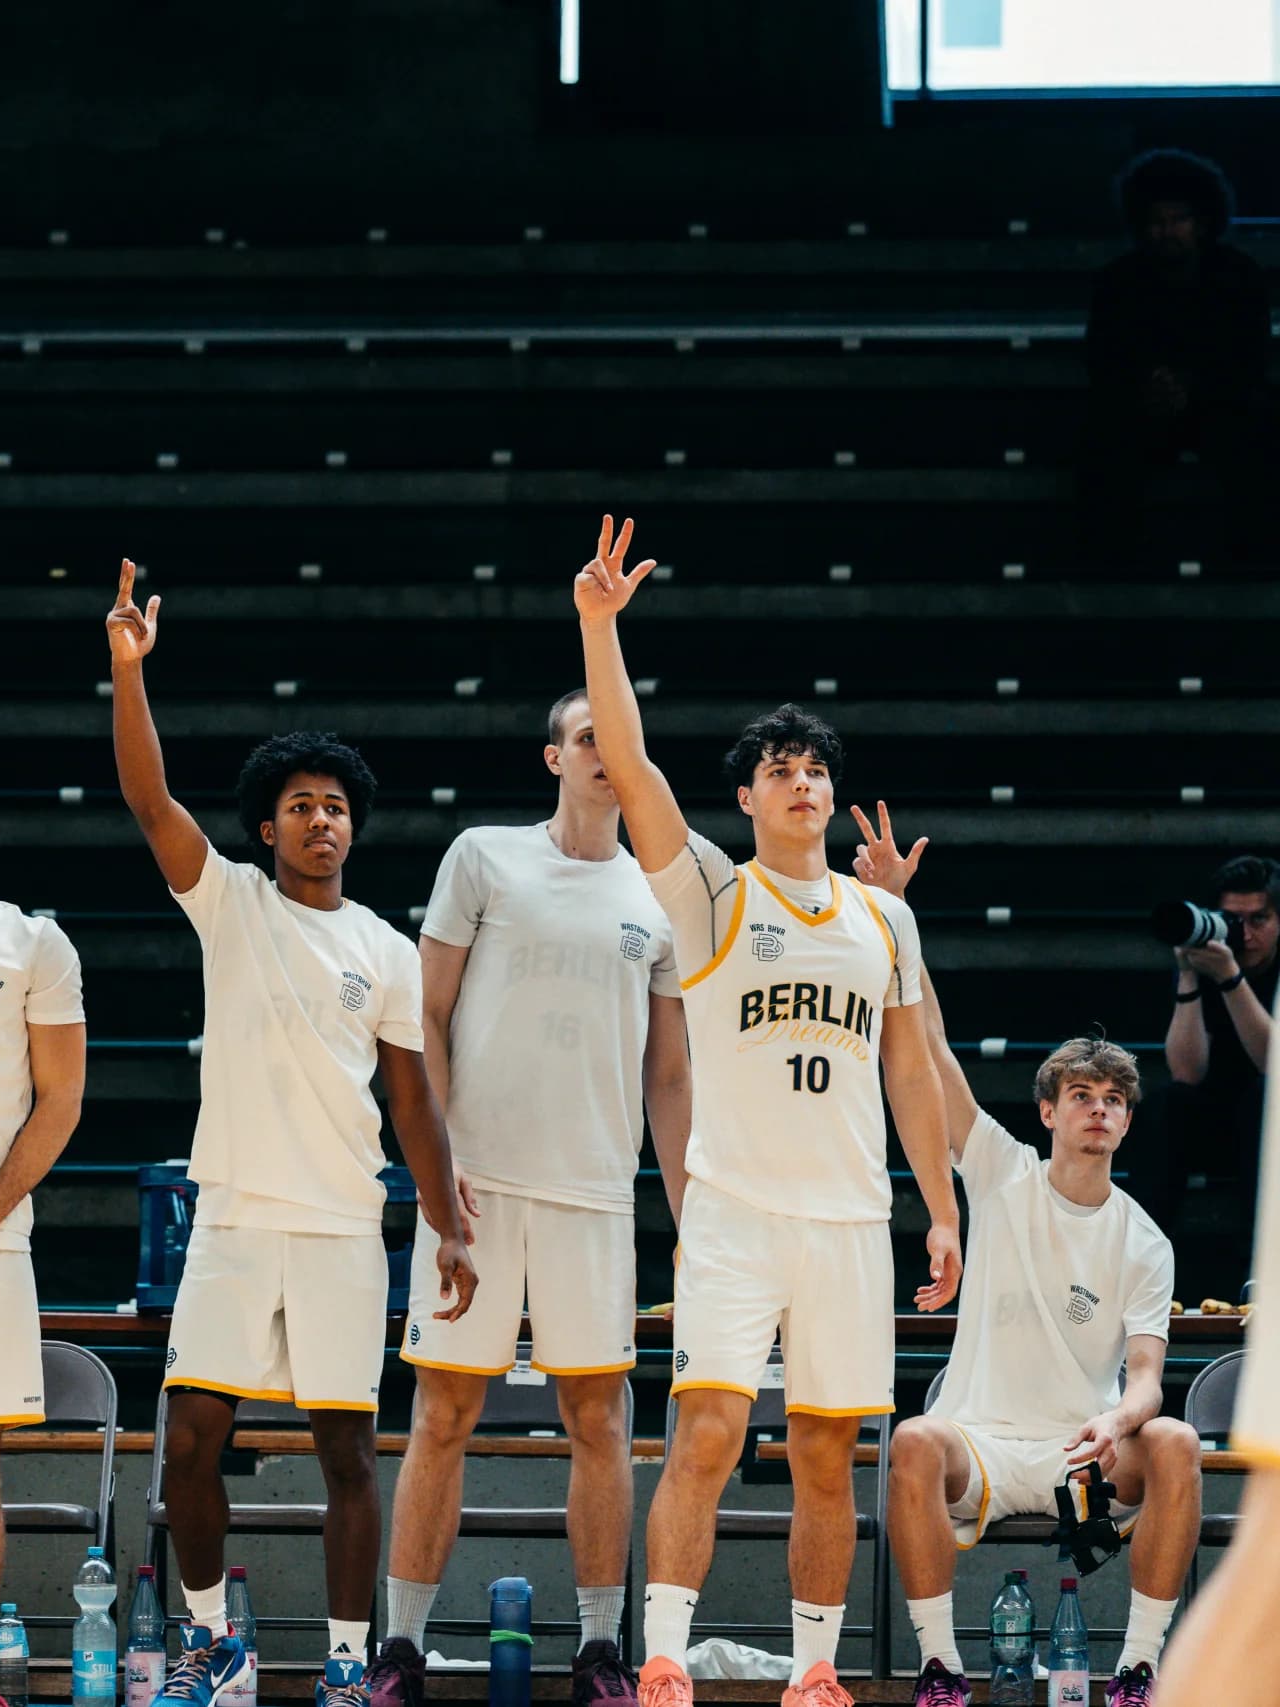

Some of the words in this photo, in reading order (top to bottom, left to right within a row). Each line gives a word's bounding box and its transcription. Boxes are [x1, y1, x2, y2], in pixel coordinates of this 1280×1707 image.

[736, 1002, 869, 1062] Dreams
[739, 982, 874, 1044] BERLIN
[786, 1053, 831, 1094] 10
